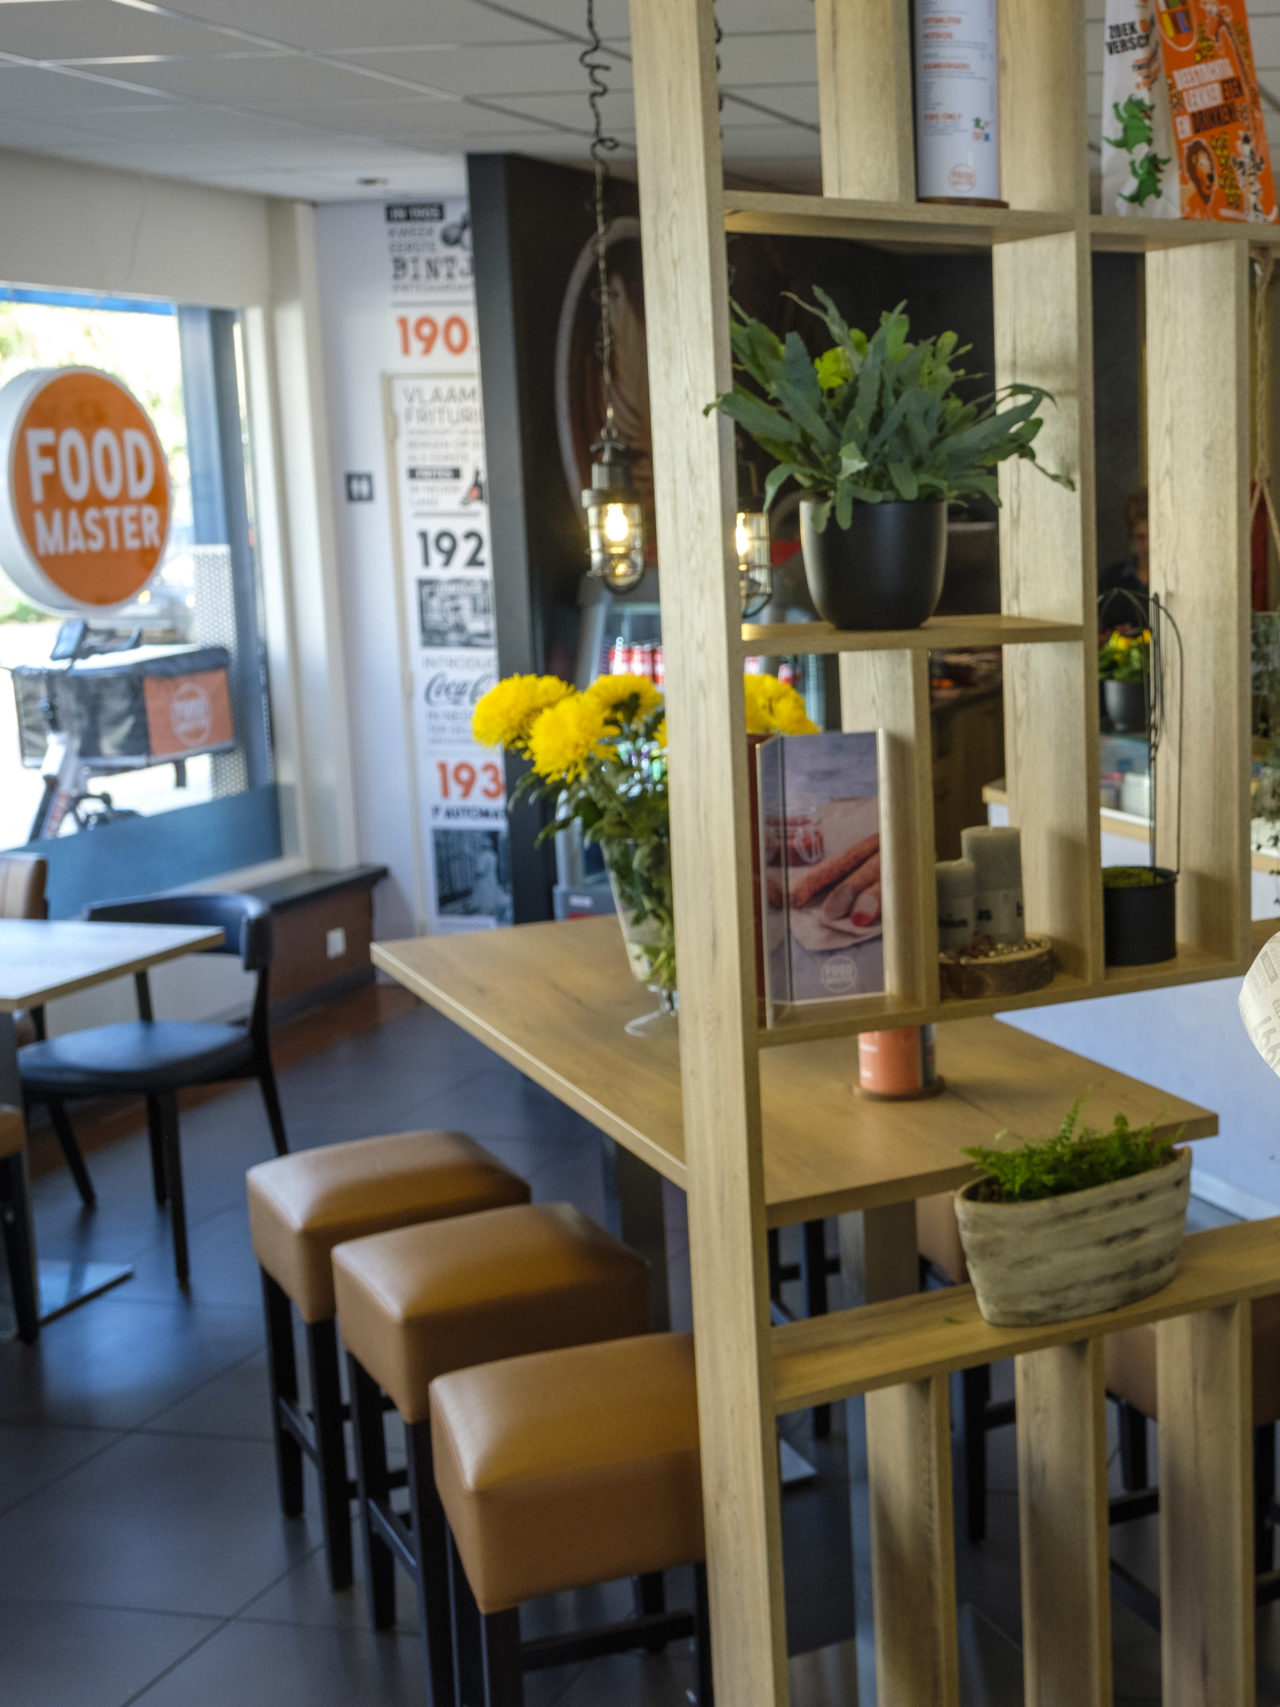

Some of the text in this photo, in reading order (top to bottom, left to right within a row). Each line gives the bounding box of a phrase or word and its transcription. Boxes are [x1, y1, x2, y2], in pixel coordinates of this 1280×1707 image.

[1108, 20, 1138, 39] ZOEK
[397, 315, 470, 356] 190
[26, 427, 154, 503] FOOD
[34, 505, 161, 556] MASTER
[418, 529, 485, 567] 192
